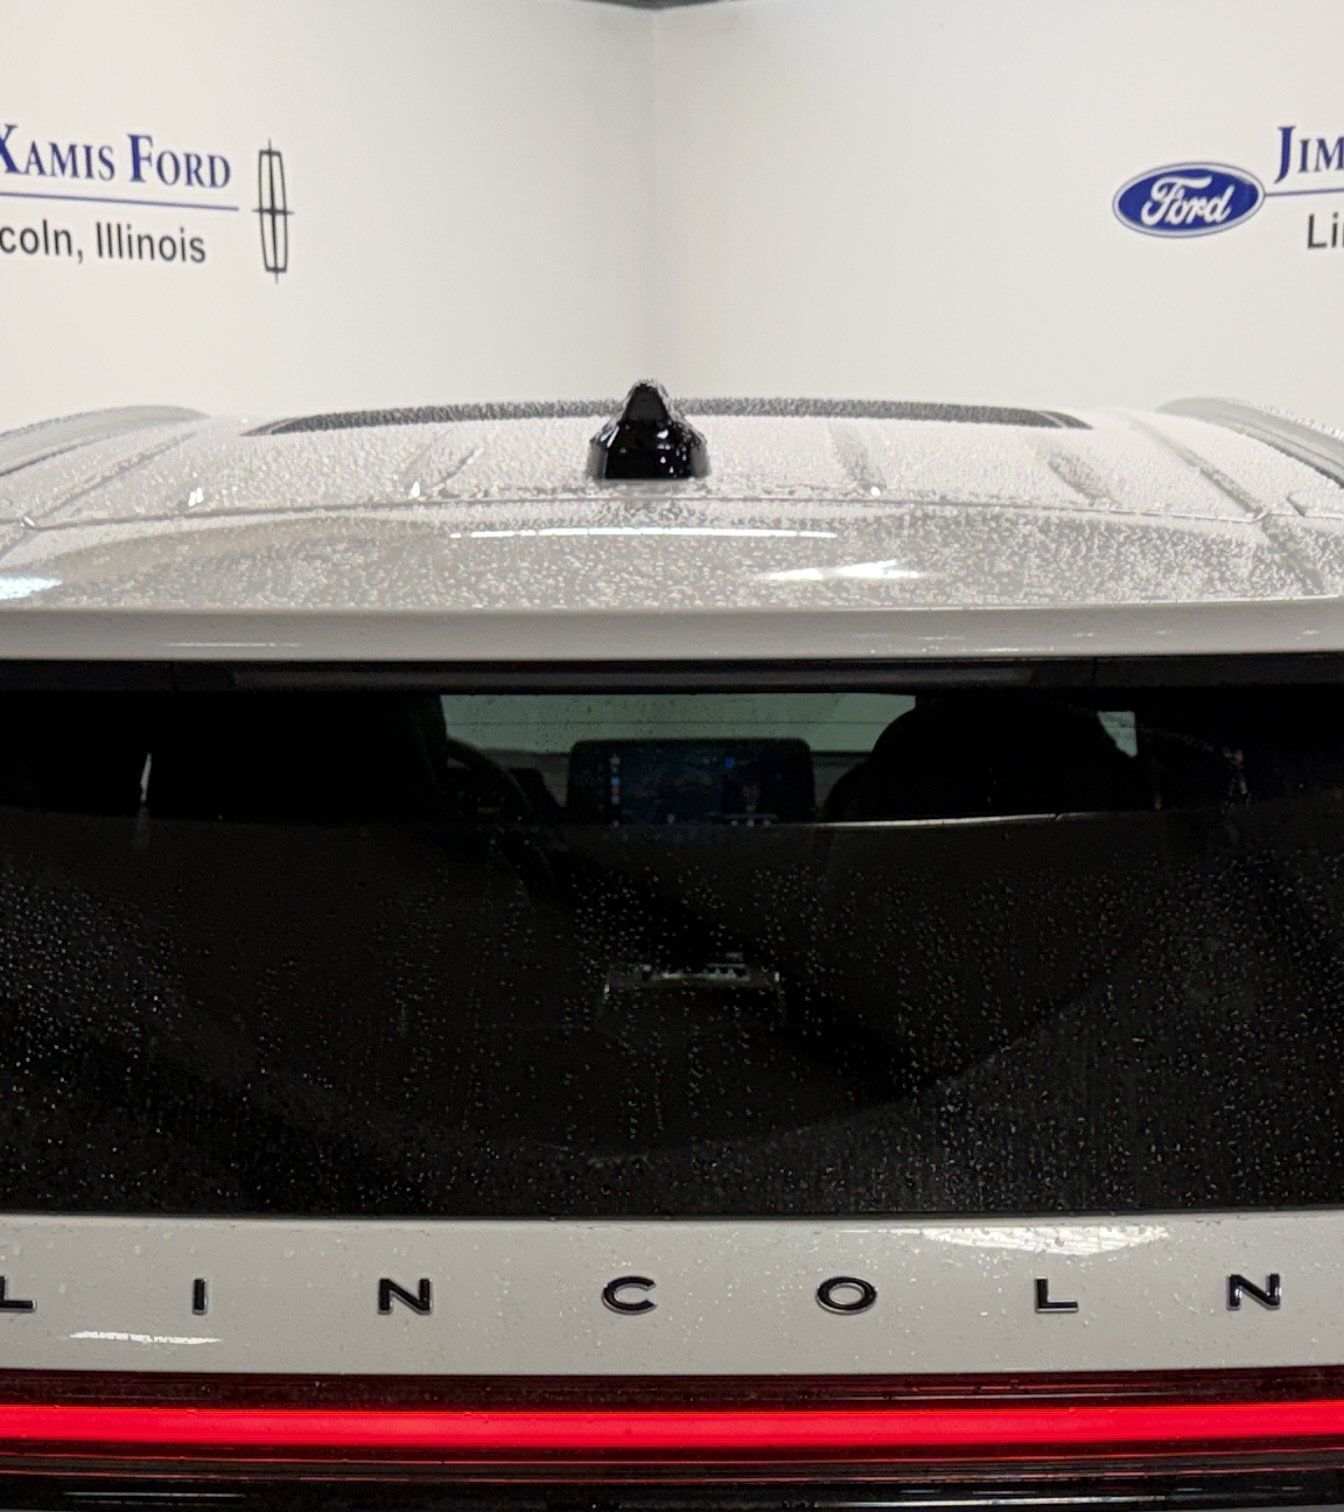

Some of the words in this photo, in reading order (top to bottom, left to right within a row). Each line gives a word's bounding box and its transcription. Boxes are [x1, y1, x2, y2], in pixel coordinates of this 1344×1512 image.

[128, 133, 231, 188] FORD
[1141, 176, 1231, 225] Ford
[96, 223, 206, 262] Illinois
